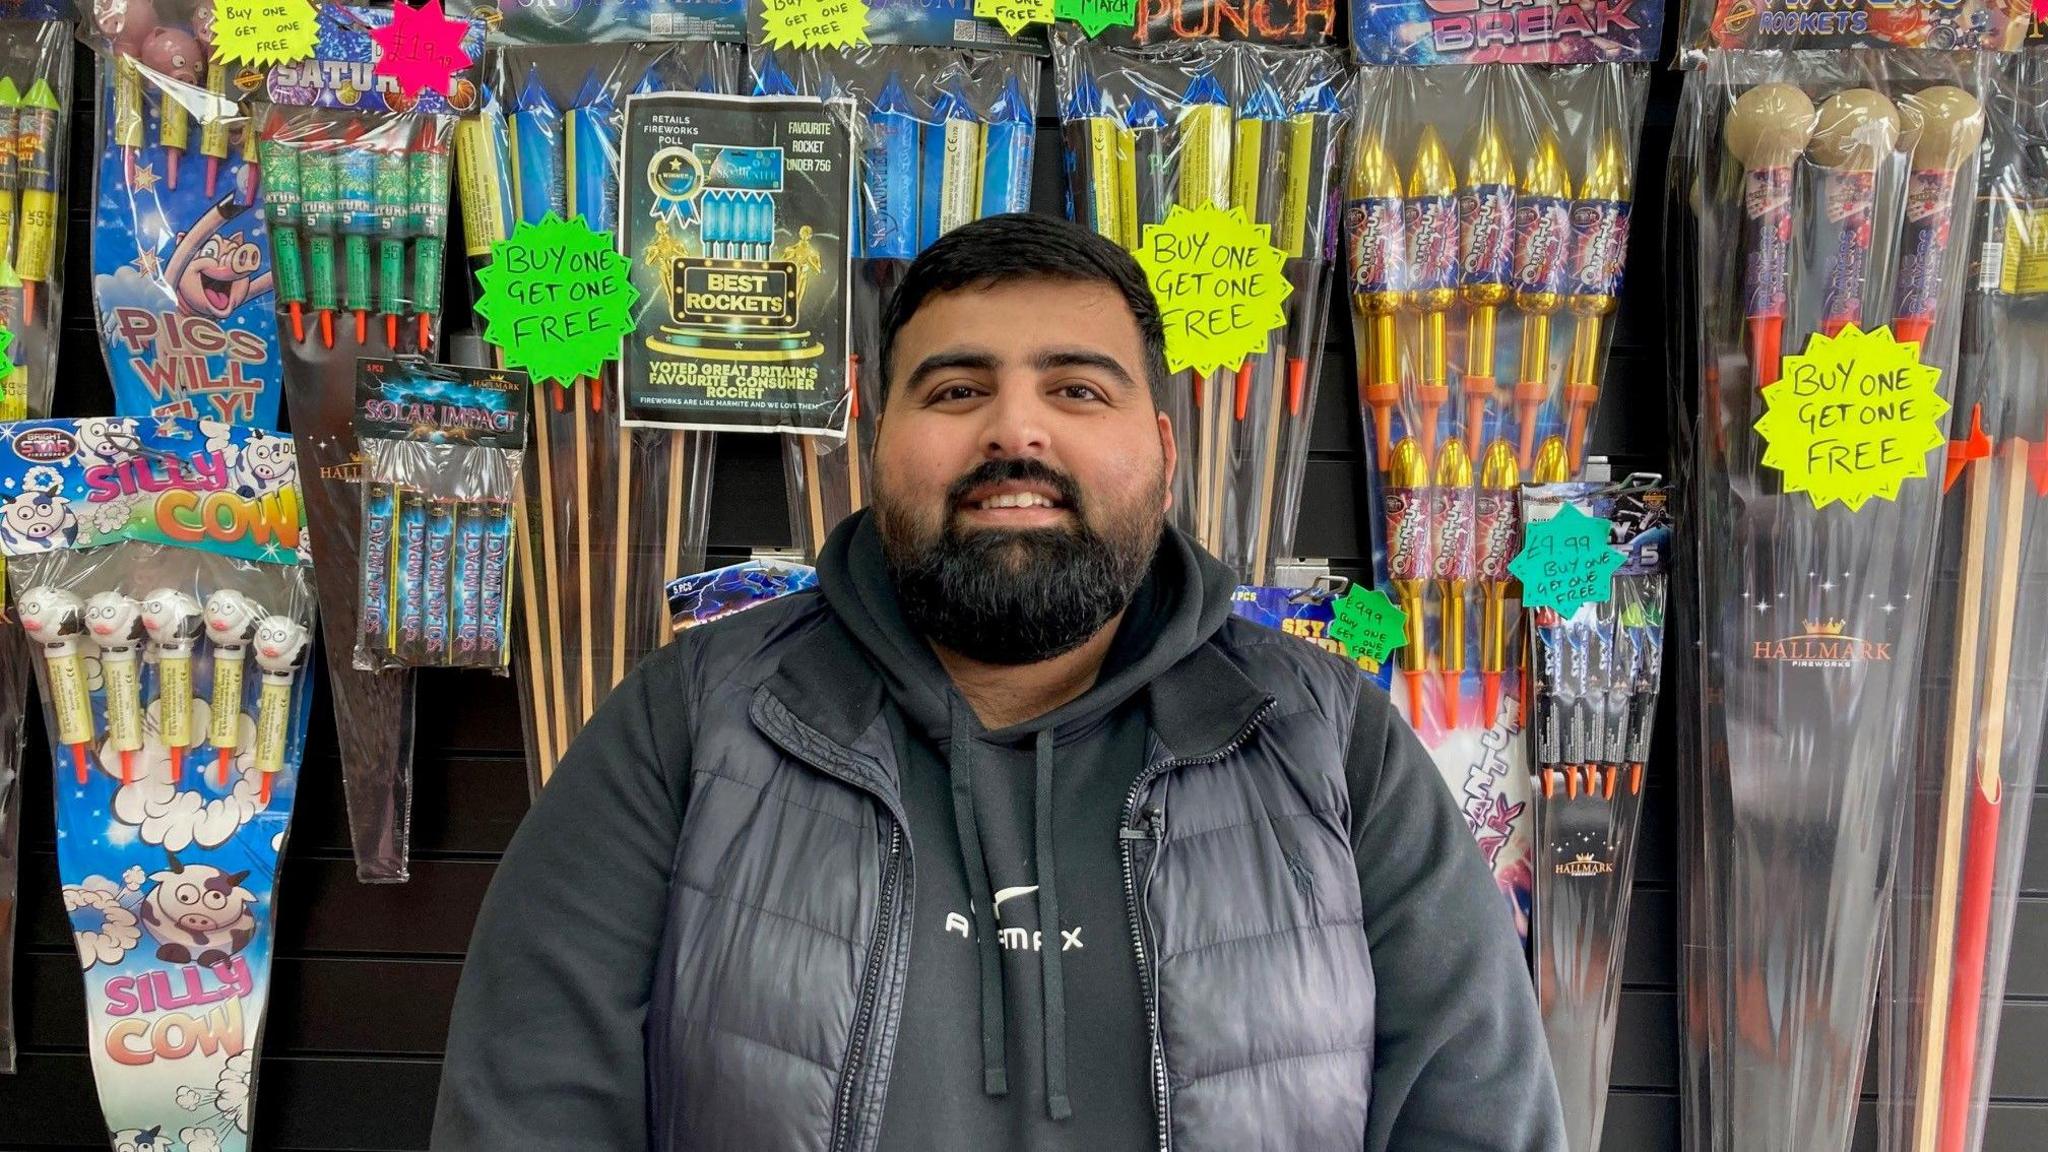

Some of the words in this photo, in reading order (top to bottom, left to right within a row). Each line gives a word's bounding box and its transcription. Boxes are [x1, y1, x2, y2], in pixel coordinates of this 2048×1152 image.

[262, 6, 288, 17] ONE
[785, 13, 808, 27] GET
[821, 3, 848, 17] ONE
[995, 6, 1037, 20] FREE
[235, 26, 257, 37] GET
[276, 21, 300, 33] ONE
[802, 20, 841, 40] FREE
[1133, 0, 1335, 46] PUNCH
[1433, 0, 1641, 51] BREAK
[1760, 11, 1868, 35] ROCKETS
[257, 39, 289, 53] FREE
[277, 60, 458, 95] SATUR
[644, 125, 699, 136] FIREWORKS
[652, 115, 691, 124] RETAILS
[788, 121, 831, 136] FAVOURITE
[659, 136, 683, 145] POLL
[792, 140, 824, 153] ROCKET
[786, 158, 813, 172] UNDER
[814, 159, 831, 172] 75G
[506, 245, 566, 275] BUY
[569, 249, 615, 274] ONE
[1154, 232, 1210, 264] BUY
[1212, 245, 1259, 271] ONE
[507, 280, 563, 305] GET
[569, 275, 619, 302] ONE
[707, 273, 768, 293] BEST
[1156, 269, 1211, 302] GET
[1214, 273, 1266, 299] ONE
[687, 293, 784, 313] ROCKETS
[513, 307, 612, 348] FREE
[1160, 303, 1254, 340] FREE
[114, 306, 268, 365] PIGS
[129, 354, 265, 401] WILL
[649, 361, 698, 375] VOTED
[701, 363, 749, 377] GREAT
[751, 365, 818, 379] BRITAIN'S
[1793, 358, 1856, 398] BUY
[1859, 367, 1913, 397] ONE
[472, 379, 520, 391] HALLMARK
[649, 372, 728, 387] FAVOURITE
[735, 376, 815, 391] CONSUMER
[706, 386, 765, 399] ROCKET
[640, 396, 682, 405] FIREWORKS
[683, 398, 698, 406] ARE
[716, 400, 749, 408] MARMITE
[780, 402, 798, 410] LOVE
[798, 402, 818, 410] THEM
[364, 398, 436, 426] SOLAR
[439, 404, 520, 433] IMPACT
[1798, 403, 1857, 435] GET
[1859, 398, 1918, 426] ONE
[20, 440, 71, 454] STAR
[27, 432, 62, 441] BRIGHT
[1806, 437, 1905, 478] FREE
[85, 450, 230, 503] SILLY
[154, 481, 300, 548] COW
[367, 512, 386, 577] IMPACT
[407, 520, 426, 583] IMPACT
[429, 532, 446, 592] IMPACT
[464, 532, 482, 592] IMPACT
[485, 532, 505, 593] IMPACT
[1544, 558, 1580, 577] BUY
[673, 584, 679, 593] 5
[679, 582, 693, 592] PCS
[1569, 571, 1598, 588] ONE
[1236, 592, 1257, 602] PCS
[1555, 586, 1597, 604] FREE
[366, 578, 385, 635] SOLAR
[404, 584, 424, 641] SOLAR
[426, 593, 446, 652] SOLAR
[461, 593, 481, 653] SOLAR
[482, 592, 502, 652] SOLAR
[1281, 618, 1325, 638] SKY
[1362, 640, 1383, 652] ONE
[1363, 629, 1387, 642] ONE
[1351, 645, 1383, 660] FREE
[1753, 640, 1892, 661] HALLMARK
[1792, 660, 1851, 668] FIREWORKS
[1462, 695, 1522, 837] ANTUM
[1555, 861, 1614, 874] HALLMARK
[104, 957, 254, 1017] SILLY
[105, 994, 247, 1066] COW
